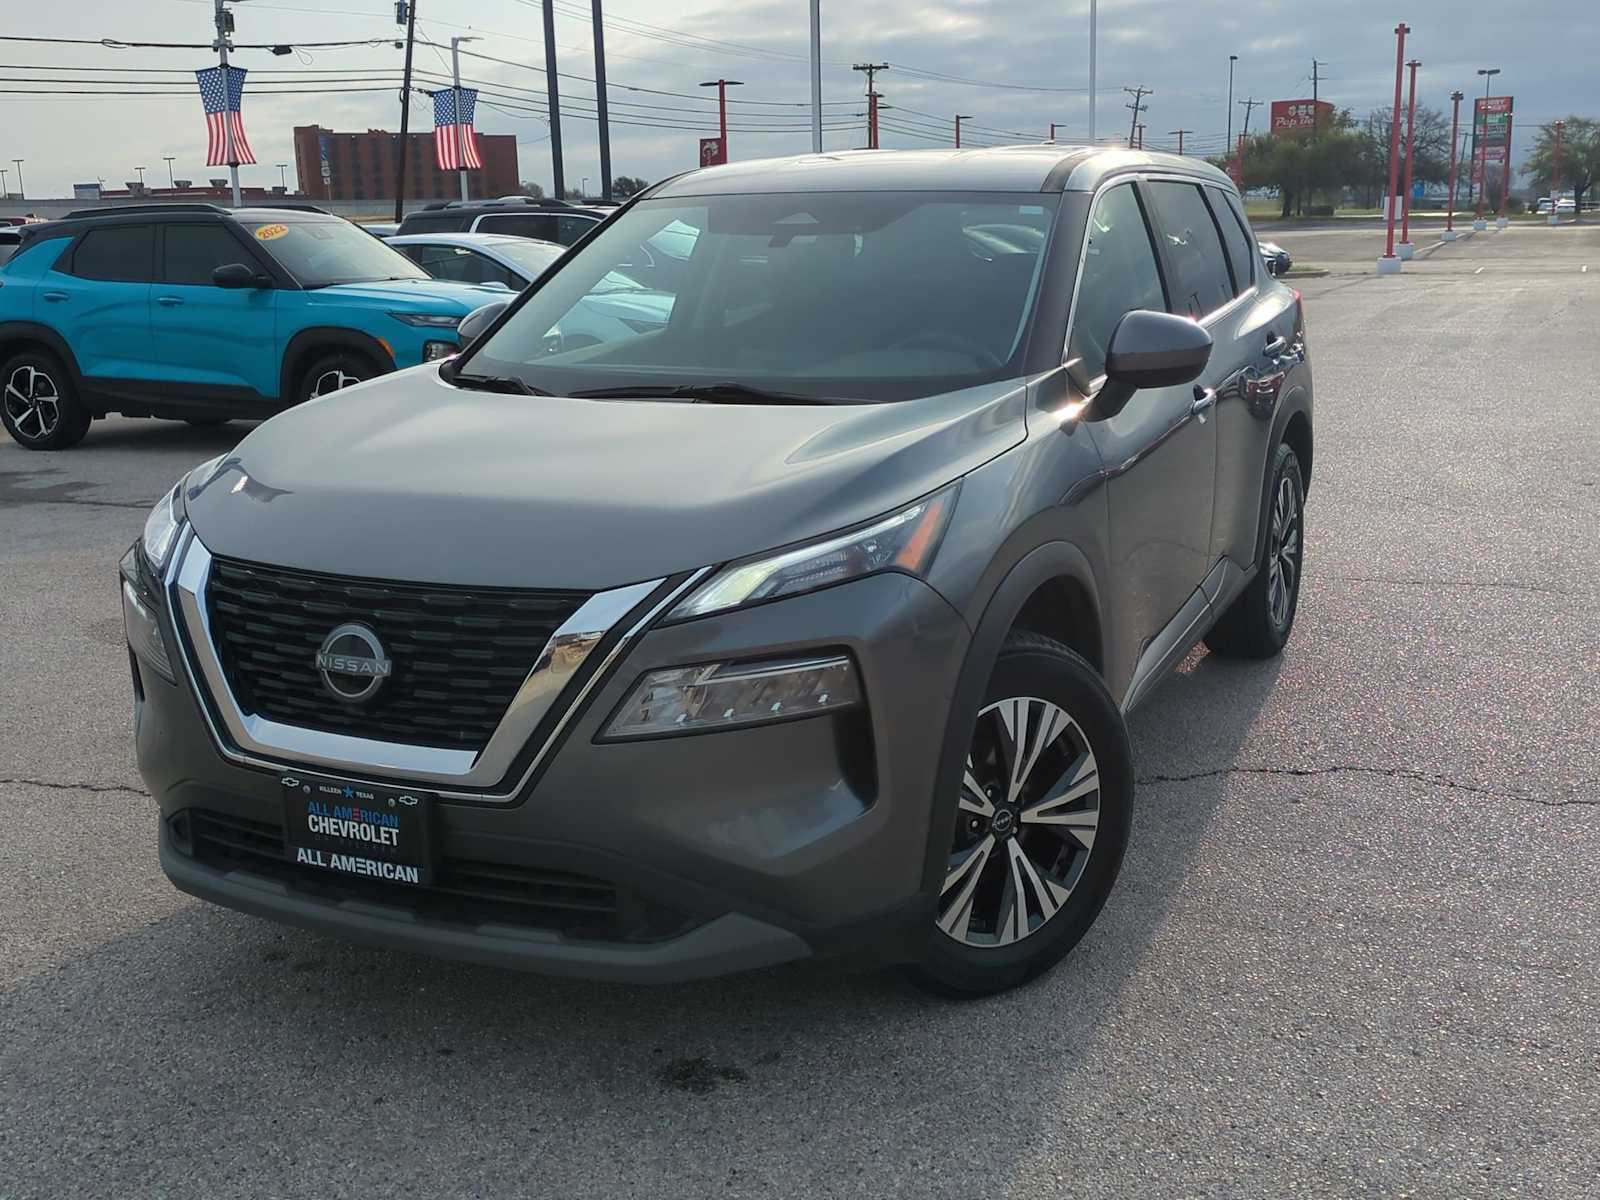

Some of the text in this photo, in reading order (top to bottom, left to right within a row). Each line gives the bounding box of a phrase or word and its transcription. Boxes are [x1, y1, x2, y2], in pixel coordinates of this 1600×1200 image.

[317, 655, 389, 673] NISSAN
[319, 785, 374, 800] KILLEEN TEXAS
[307, 801, 399, 827] ALL AMERICAN
[308, 814, 399, 846] CHEVROLET
[297, 848, 419, 883] ALL AMERICAN
